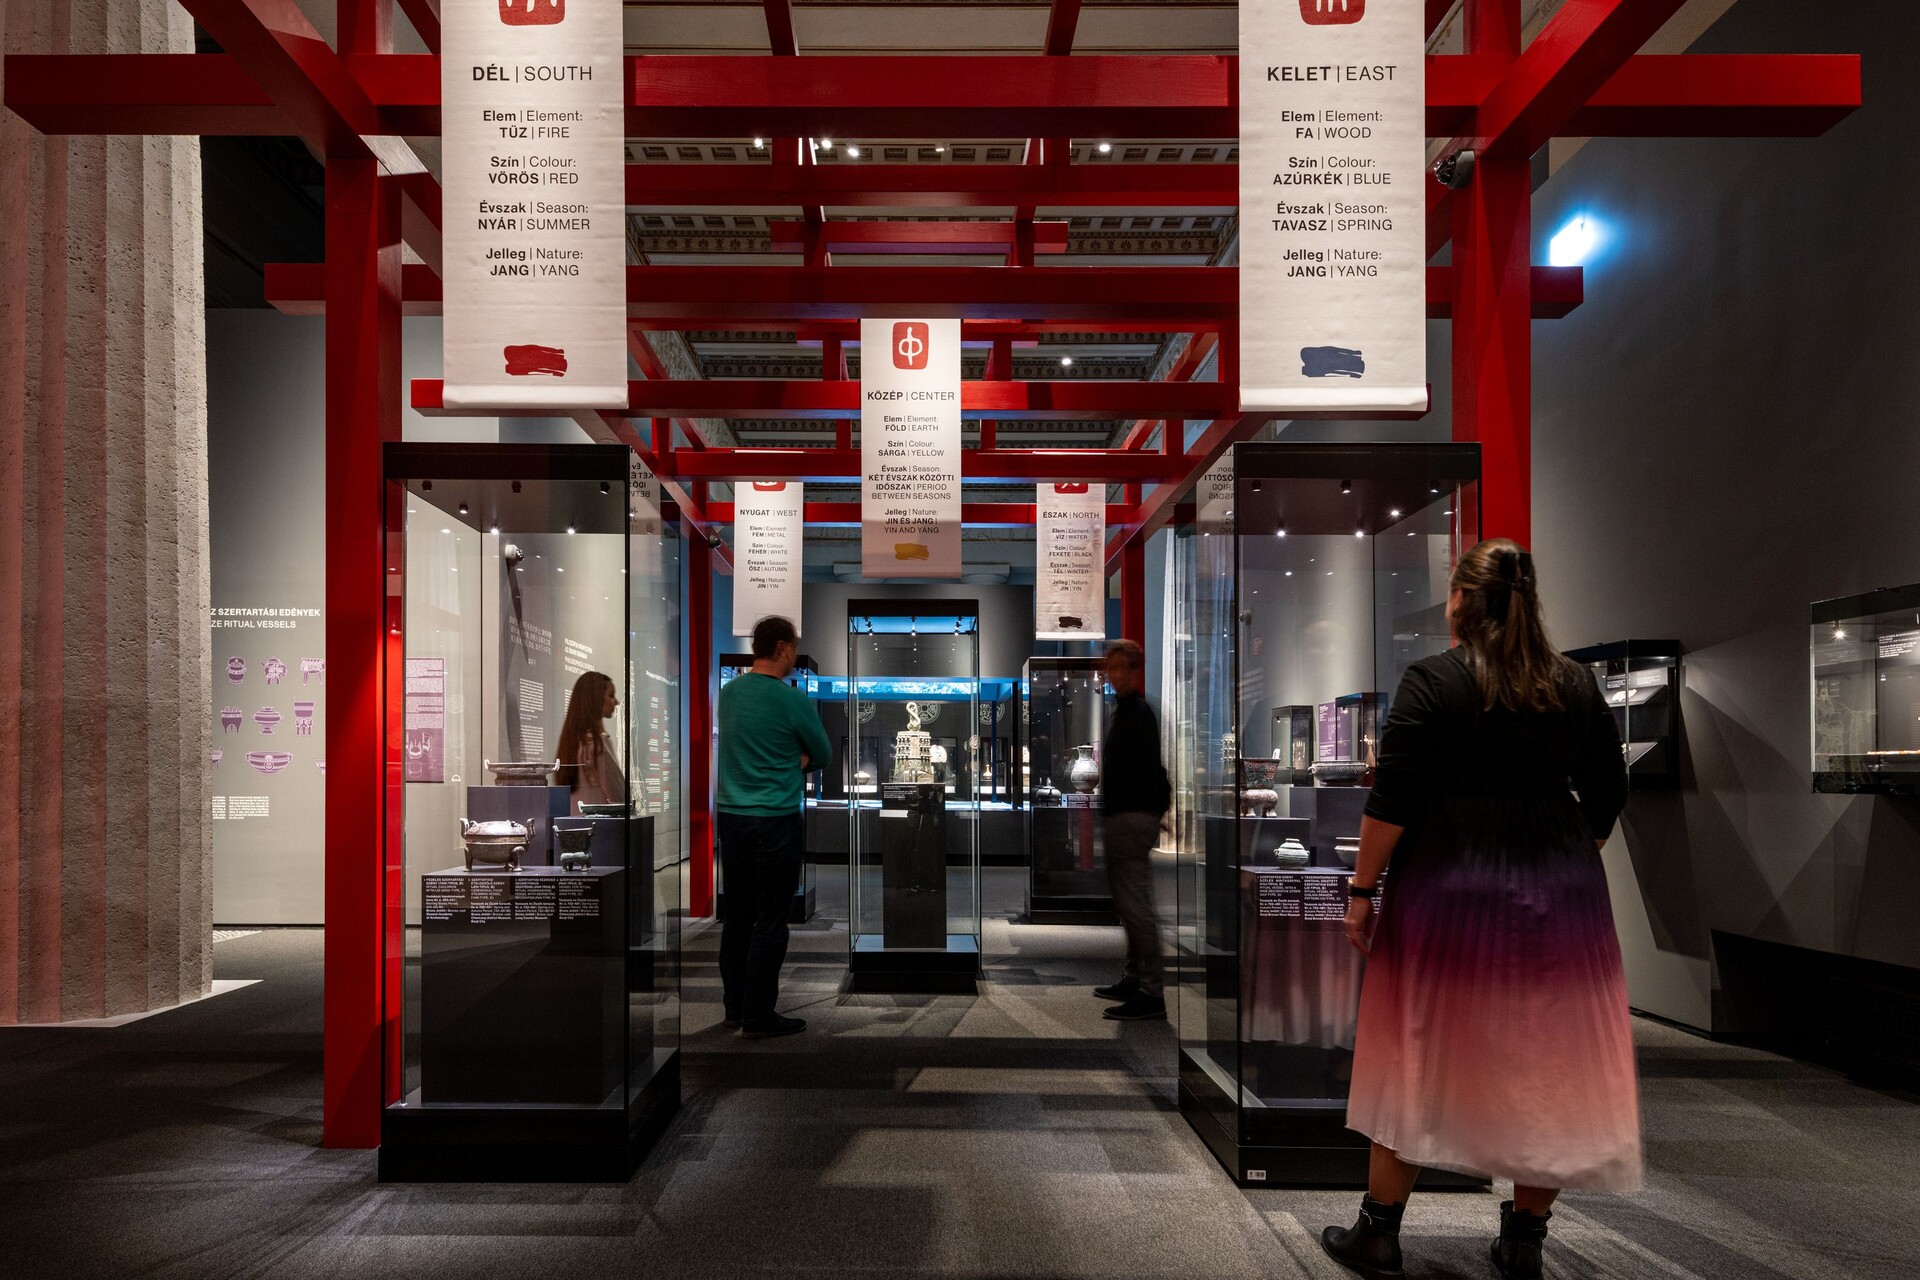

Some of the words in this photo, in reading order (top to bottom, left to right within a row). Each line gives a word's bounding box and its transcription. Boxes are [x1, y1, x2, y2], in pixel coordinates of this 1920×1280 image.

[473, 63, 510, 81] DÉL
[524, 66, 592, 81] SOUTH
[1268, 66, 1331, 81] KELET
[1346, 66, 1397, 81] EAST
[483, 110, 516, 121] Elem
[527, 110, 583, 121] Element:
[1282, 111, 1315, 122] Elem
[1326, 110, 1383, 122] Element:
[499, 125, 527, 138] TŰZ
[538, 127, 570, 138] FIRE
[1296, 127, 1313, 138] FA
[1324, 127, 1371, 138] WOOD
[491, 156, 519, 167] Szín
[529, 156, 576, 167] Colour:
[1289, 157, 1317, 168] Szín
[1328, 156, 1376, 168] Colour:
[488, 171, 539, 184] VÖRÖS
[550, 173, 579, 184] RED
[1273, 171, 1343, 185] AZÚRKÉK
[1354, 173, 1391, 184] BLUE
[480, 200, 526, 213] Évszak
[536, 202, 589, 213] Season:
[1277, 201, 1324, 214] Évszak
[1335, 202, 1388, 214] Season:
[478, 217, 516, 230] NYÁR
[527, 218, 590, 230] SUMMER
[1272, 220, 1327, 231] TAVASZ
[1338, 219, 1392, 231] SPRING
[486, 248, 526, 261] Jelleg
[537, 248, 583, 259] Nature:
[1283, 249, 1323, 262] Jelleg
[1334, 249, 1382, 260] Nature:
[490, 265, 529, 276] JANG
[539, 265, 579, 276] YANG
[1287, 266, 1326, 277] JANG
[1337, 265, 1378, 277] YANG
[868, 390, 903, 400] KÖZÉP
[911, 392, 955, 400] CENTER
[878, 448, 906, 456] SÁRGA
[869, 473, 885, 481] KÉT
[886, 473, 918, 481] ÉVSZAK
[900, 516, 910, 524] ÉS
[218, 608, 277, 616] SZERTARTÁSI
[279, 608, 320, 616] EDÉNYEK
[224, 620, 255, 628] RITUAL
[257, 620, 296, 628] VESSELS
